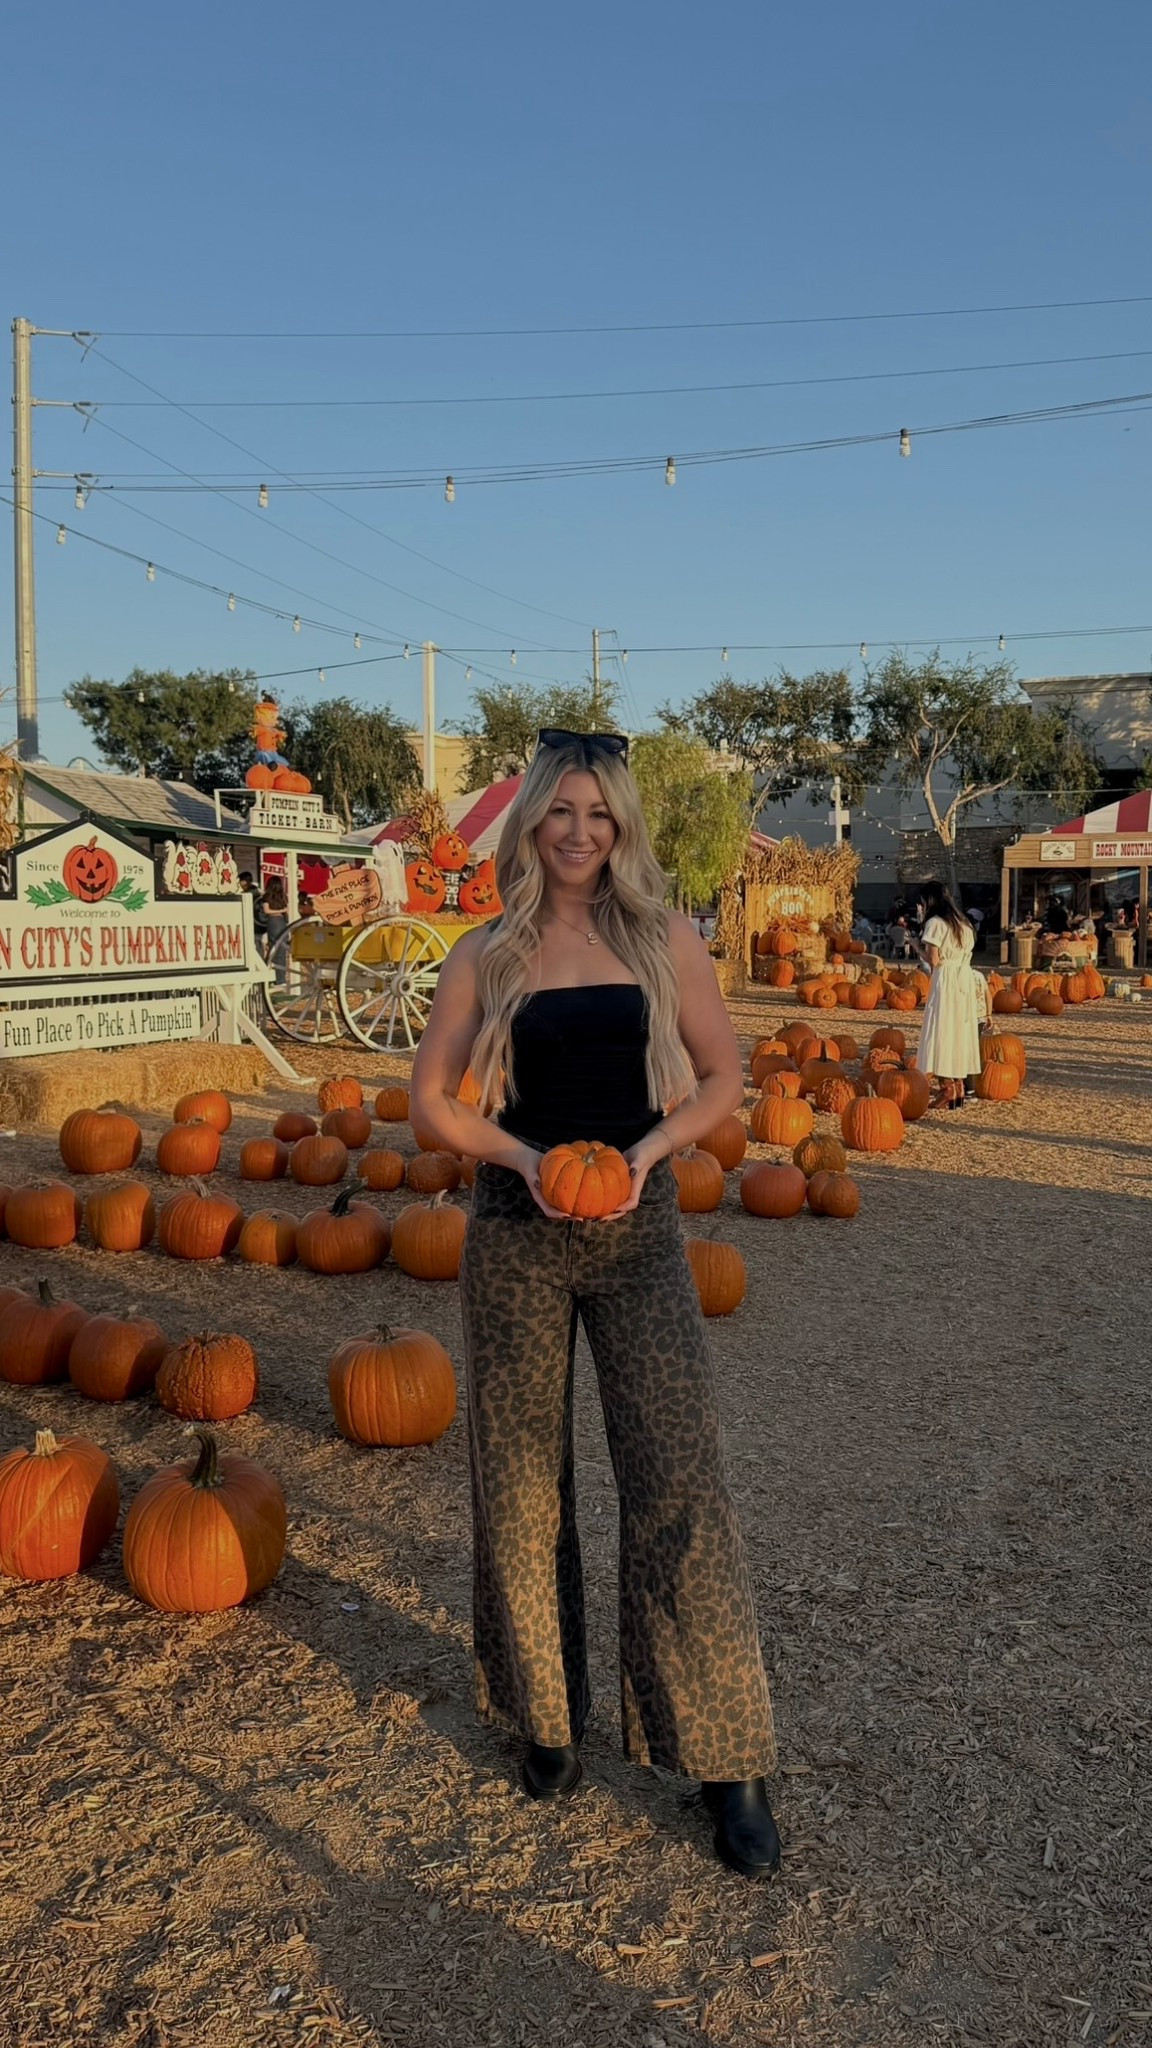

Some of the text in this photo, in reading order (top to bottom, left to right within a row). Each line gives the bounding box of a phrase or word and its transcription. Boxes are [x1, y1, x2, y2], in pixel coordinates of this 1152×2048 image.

[259, 813, 297, 827] TICKET
[305, 817, 333, 830] BARN
[1096, 843, 1118, 857] ROCKY
[26, 860, 59, 872] Since
[123, 865, 144, 875] 1978
[320, 875, 370, 900] THE FUN PLACE
[343, 893, 354, 902] TO
[60, 908, 121, 918] Welcome to
[326, 893, 378, 920] PICK A PUMPKIN
[781, 902, 803, 916] BOO
[21, 926, 93, 970] CITY'S
[100, 925, 188, 966] PUMPKIN
[193, 924, 242, 961] FARM
[4, 1020, 31, 1048] Fun
[36, 1016, 72, 1044] Place
[76, 1013, 93, 1040] To
[98, 1010, 124, 1038] Pick
[128, 1009, 137, 1035] A
